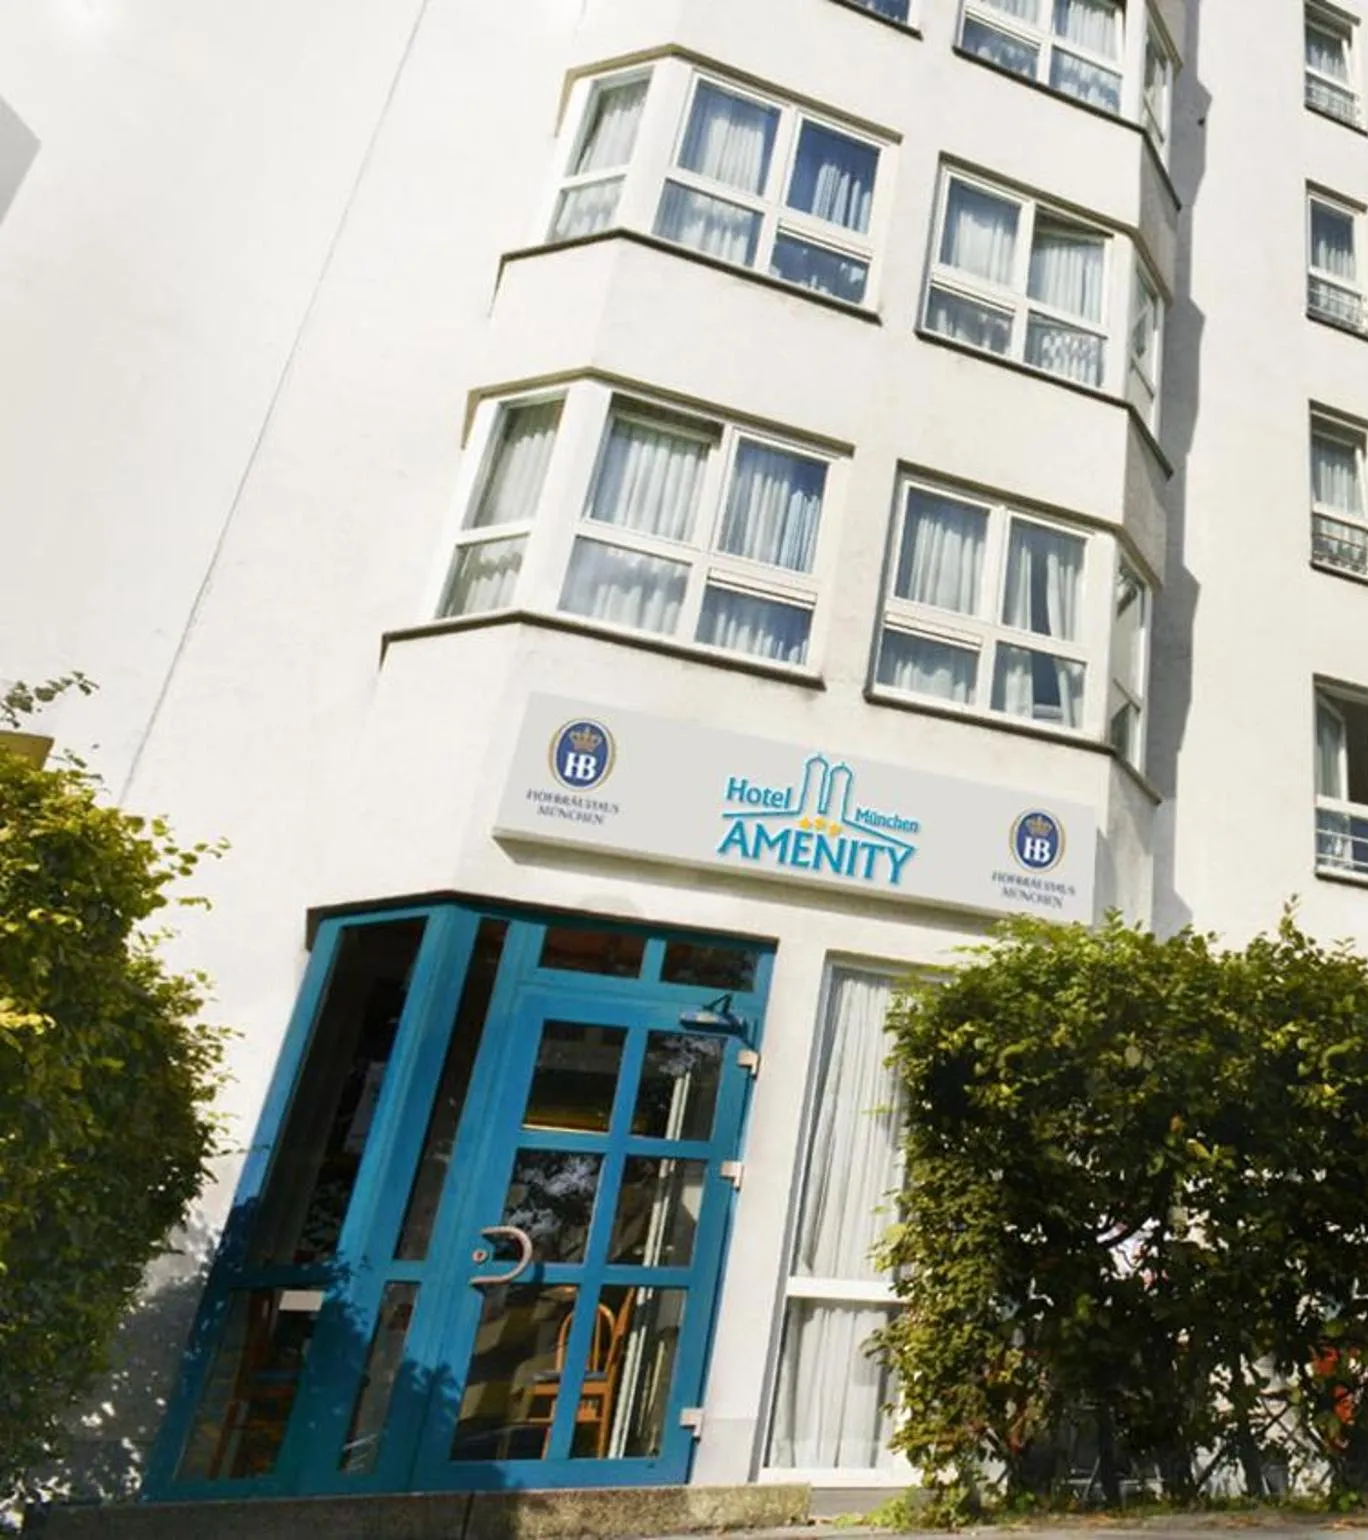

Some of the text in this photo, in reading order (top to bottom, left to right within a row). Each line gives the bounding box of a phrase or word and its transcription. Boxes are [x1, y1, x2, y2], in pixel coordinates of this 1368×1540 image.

[563, 751, 598, 781] HB
[726, 776, 793, 810] Hotel
[855, 806, 920, 834] München
[717, 819, 916, 885] AMENITY
[1023, 837, 1051, 862] HB
